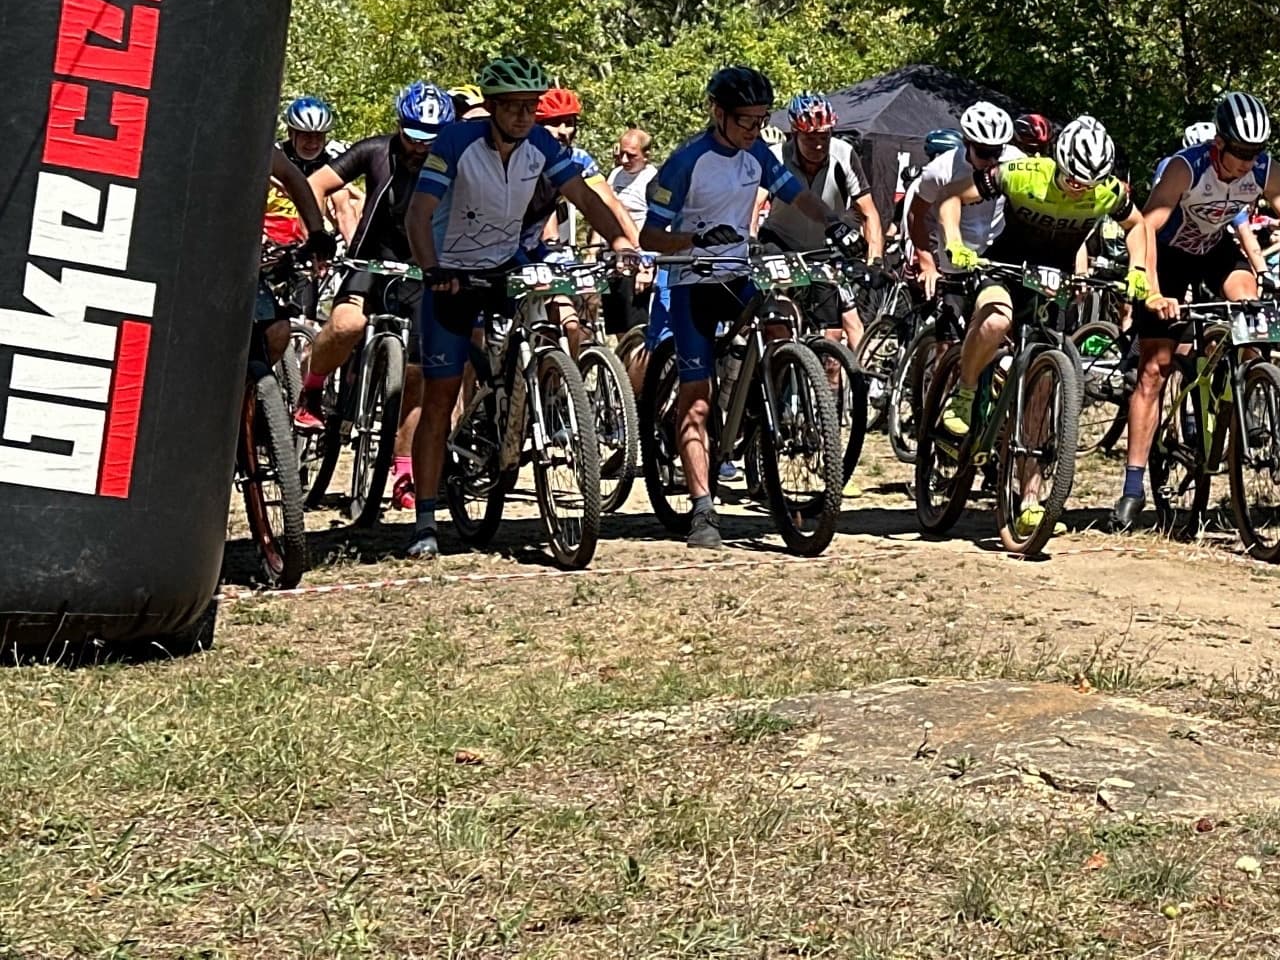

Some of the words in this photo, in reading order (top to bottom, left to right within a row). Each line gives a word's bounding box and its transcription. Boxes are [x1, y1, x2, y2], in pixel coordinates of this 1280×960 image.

[1016, 206, 1097, 230] RIBBLE
[764, 260, 791, 280] 15
[1038, 270, 1060, 290] 10
